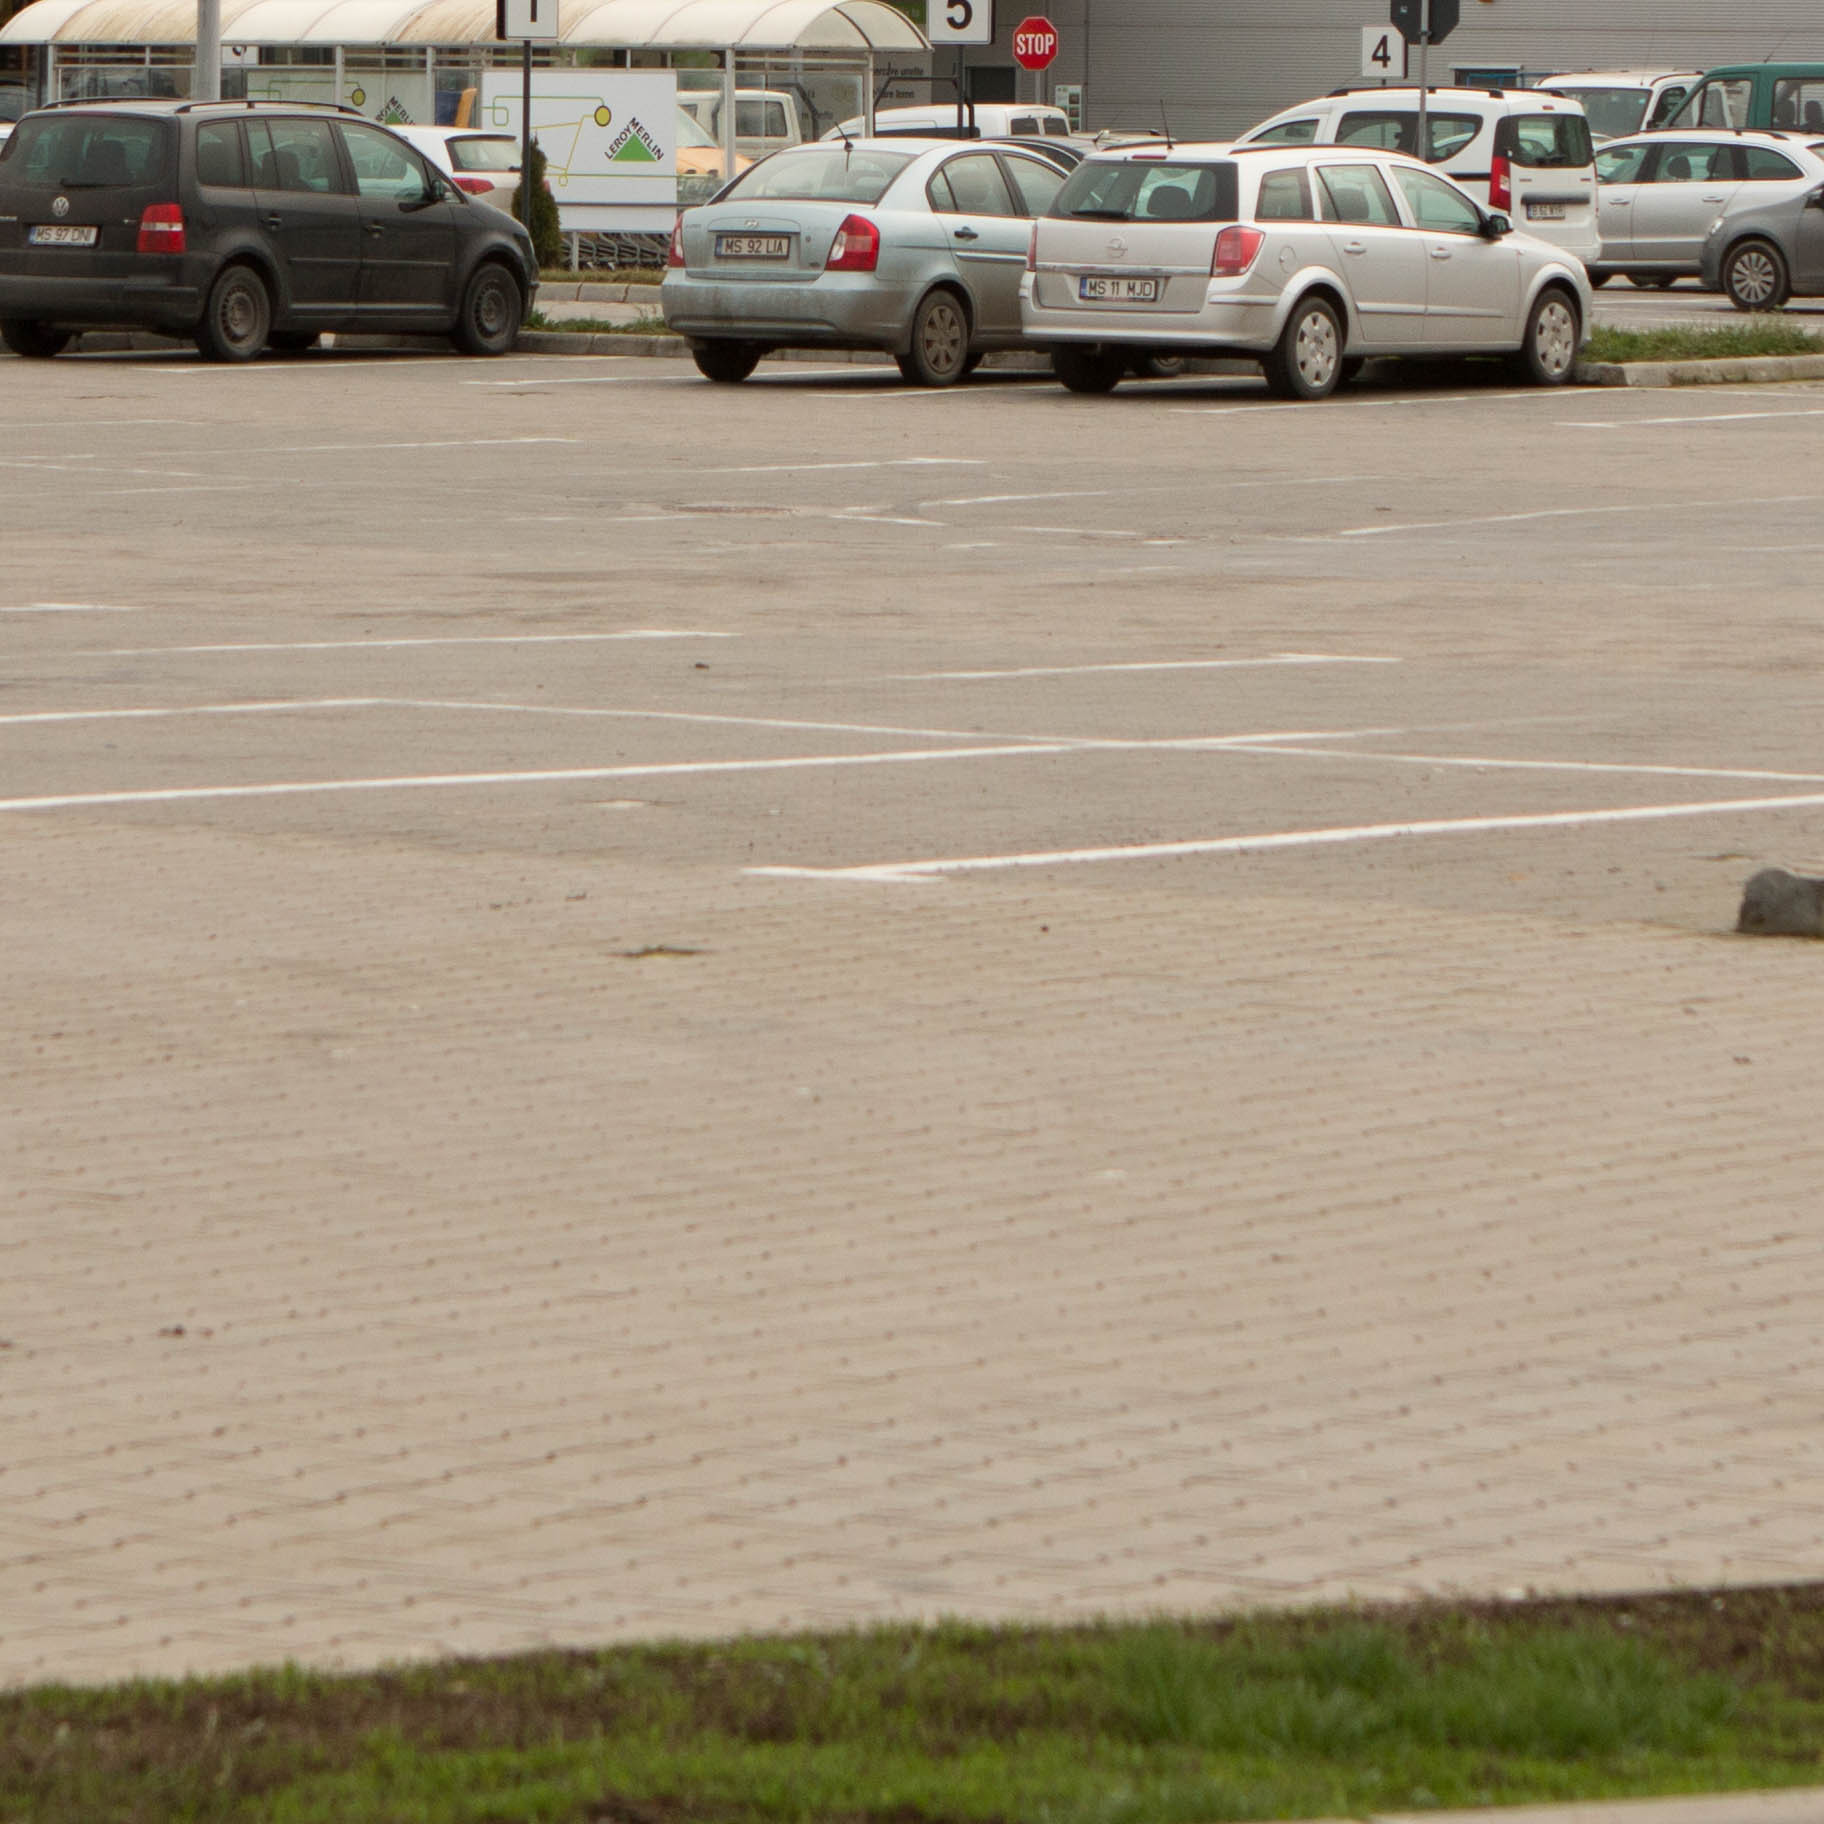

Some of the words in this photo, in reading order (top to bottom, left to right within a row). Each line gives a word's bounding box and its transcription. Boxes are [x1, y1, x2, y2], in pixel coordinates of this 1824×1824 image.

[1016, 33, 1055, 55] STOP
[1371, 35, 1392, 68] 4
[604, 124, 632, 160] LEROY
[629, 116, 665, 161] MERLIN
[726, 237, 742, 254] MS
[748, 237, 763, 254] 92
[766, 238, 784, 255] LIA
[1089, 280, 1106, 295] MS
[1111, 281, 1120, 295] 11
[1127, 281, 1153, 297] MJD
